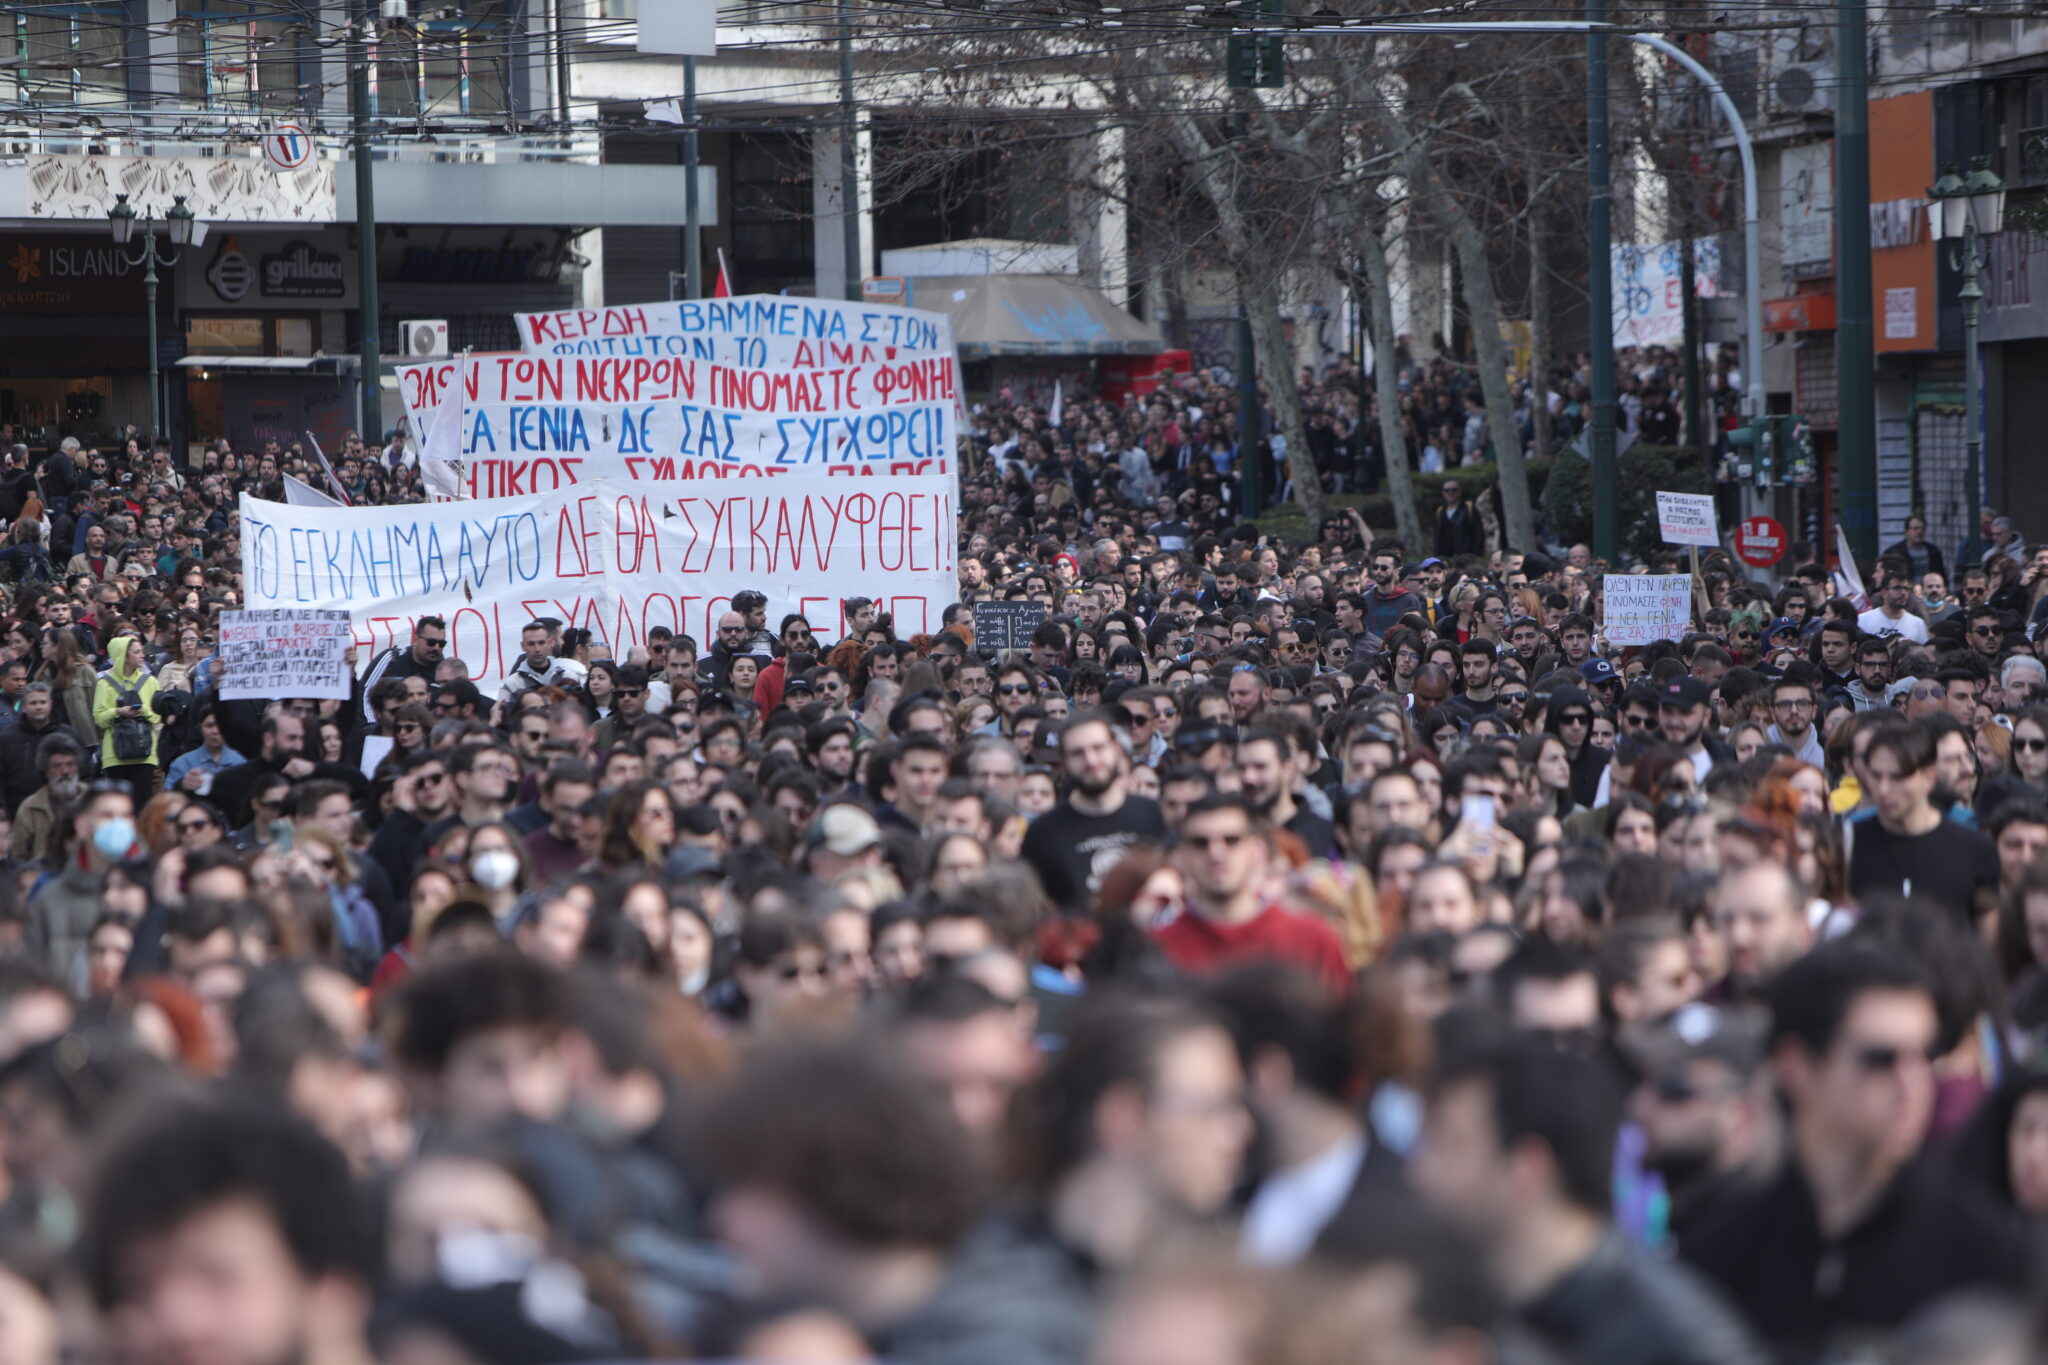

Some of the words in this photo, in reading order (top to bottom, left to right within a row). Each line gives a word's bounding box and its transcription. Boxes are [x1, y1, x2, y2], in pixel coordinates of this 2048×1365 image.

[50, 247, 129, 277] ISLAND
[266, 248, 342, 285] grillaki
[528, 308, 648, 345] ΚΕΡΔΗ
[679, 301, 846, 340] ΒΑΜΜΕΝΑ
[860, 313, 938, 350] ΣΤΩΝ
[496, 358, 563, 402] ΤΩΝ
[576, 356, 695, 403] ΝΕΚΡΩΝ
[710, 365, 862, 413] ΓΙΝΟΜΑΣΤΕ
[872, 356, 954, 406] ΦΩΝΗ!
[510, 406, 591, 452] ΓΕΝΙΑ
[617, 406, 656, 454] ΔΕ
[680, 405, 742, 462] ΣΑΣ
[775, 407, 945, 465] ΣΥΓΧΩΡΕΙ!
[245, 516, 279, 600] ΤΟ
[290, 521, 449, 602] ΕΓΚΛΗΜΑ
[452, 512, 540, 592] ΑΥΤΟ
[556, 494, 604, 578] ΔΕ
[616, 494, 662, 574] ΘΑ
[678, 491, 952, 574] ΣΥΓΚΑΛΥΦΘΕΙ!
[1605, 578, 1631, 593] ΟΛΩΝ
[1635, 578, 1654, 592] ΤΩΝ
[1658, 577, 1690, 593] ΝΕΚΡΩΝ
[1607, 595, 1658, 608] ΓΙΝΟΜΑΣΤΕ
[222, 611, 232, 624] Η
[237, 609, 296, 623] ΑΛΗΘΕΙΑ
[297, 609, 312, 621] ΔΕ
[315, 609, 350, 621] ΓΙΝΕΤΑΙ
[1606, 612, 1613, 625] Η
[1619, 611, 1638, 625] ΝΕΑ
[1647, 609, 1677, 625] ΓΕΝΙΑ
[222, 625, 261, 641] ΦΟΒΟΣ
[266, 624, 278, 639] ΚΙ
[280, 625, 289, 637] Ο
[293, 623, 332, 637] ΦΟΒΟΣ
[334, 623, 350, 637] ΔΕ
[1610, 625, 1627, 640] ΔΕ
[1628, 625, 1648, 640] ΣΑΣ
[1649, 623, 1685, 640] ΣΥΓΧΩΡΕ
[221, 639, 265, 656] ΓΙΝΕΤΑΙ
[271, 661, 288, 673] ΘΑ
[290, 661, 341, 675] ΥΠΑΡΧΕΙ
[219, 676, 266, 689] ΣΗΜΕΙΟ
[268, 674, 291, 688] ΣΤΟ
[296, 674, 341, 687] ΧΑΡΤΗ
